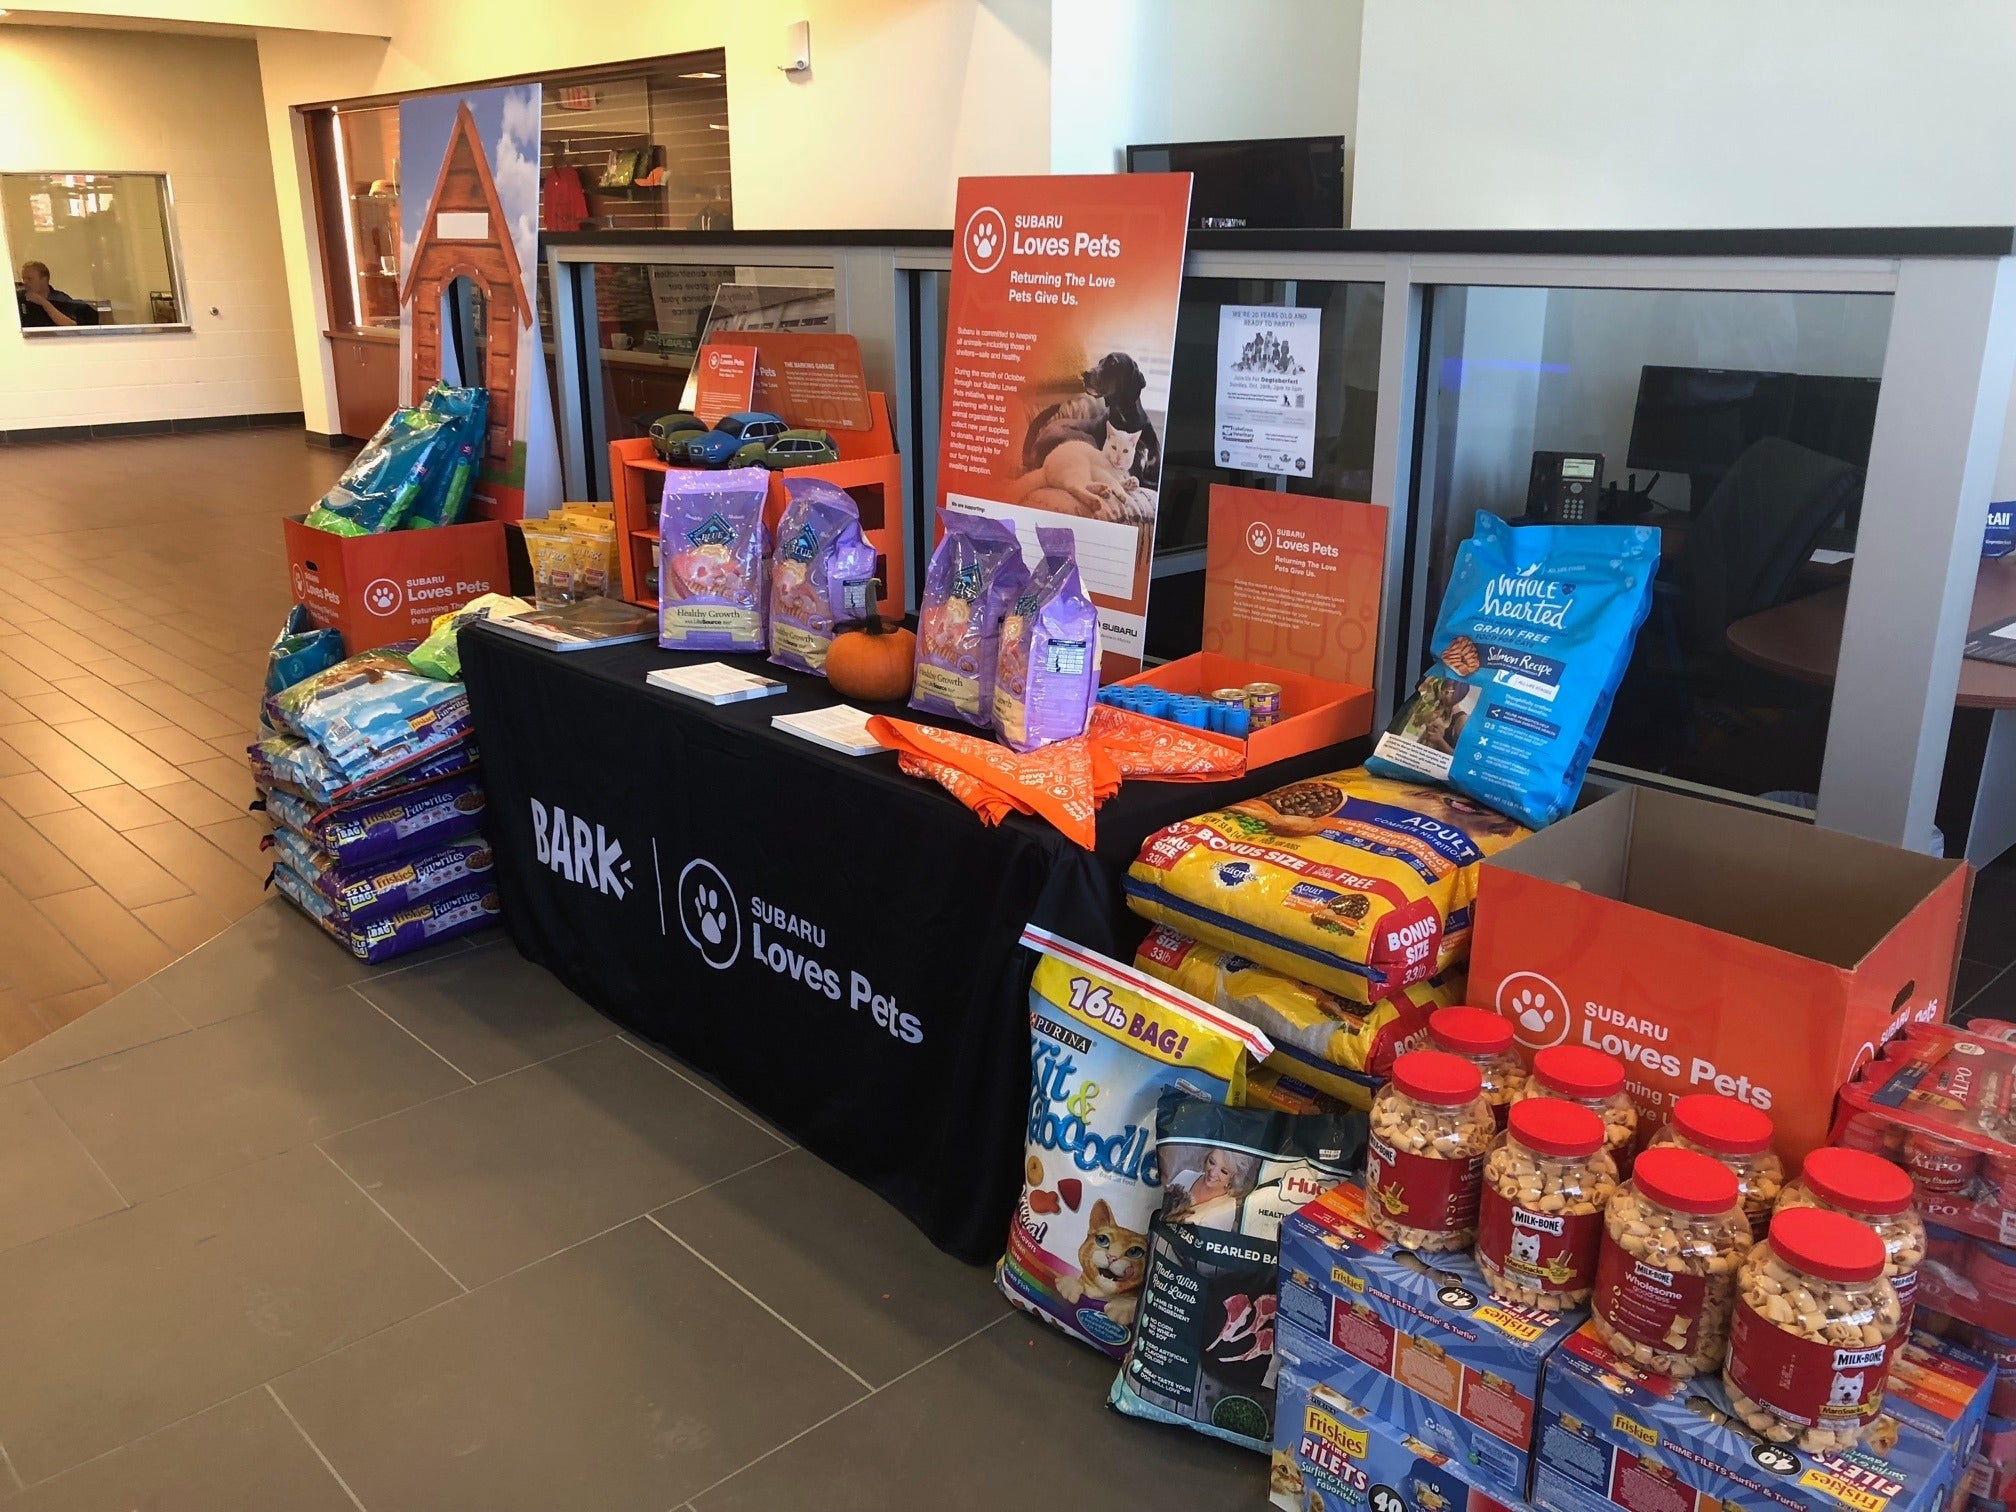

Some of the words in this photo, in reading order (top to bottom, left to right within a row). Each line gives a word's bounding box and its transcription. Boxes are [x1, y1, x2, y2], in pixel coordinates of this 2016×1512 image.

[1014, 215, 1063, 229] SUBARU
[1012, 231, 1070, 257] Loves
[1074, 232, 1121, 258] Pets
[1010, 270, 1062, 288] Returning
[1065, 273, 1085, 287] The
[1088, 275, 1116, 288] Love
[1008, 289, 1032, 303] Pets
[1034, 291, 1058, 304] Give
[1061, 293, 1078, 305] Us.
[760, 367, 776, 378] Pets
[794, 362, 815, 370] BARKING
[1260, 376, 1298, 384] Dogtoberfest
[1276, 528, 1305, 539] SUBARU
[1276, 536, 1310, 554] Loves
[1312, 542, 1339, 558] Pets
[1274, 564, 1289, 574] Pets
[1290, 566, 1304, 576] Give
[1275, 556, 1306, 568] Returning
[1307, 560, 1320, 569] The
[1321, 562, 1337, 572] Love
[406, 576, 444, 587] SUBARU
[408, 586, 452, 602] Loves
[456, 581, 490, 595] Pets
[1498, 574, 1560, 600] WHOLE
[306, 583, 323, 598] Loves
[324, 587, 340, 604] Pets
[410, 604, 449, 616] Returning
[677, 609, 706, 618] Healthy
[708, 610, 740, 618] Growth
[1479, 579, 1574, 630] hearted
[412, 617, 429, 625] Pets
[1102, 623, 1138, 637] SUBARU
[789, 631, 814, 642] Growth
[1474, 623, 1516, 636] GRAIN
[1518, 630, 1551, 644] FREE
[1488, 646, 1518, 664] Salmon
[1520, 654, 1552, 677] Recipe
[937, 674, 963, 686] Growth
[1338, 820, 1378, 835] ROASTED
[1380, 831, 1425, 850] CHICKEN,
[1427, 851, 1449, 870] RICE
[1374, 817, 1418, 834] COMPLETE
[1421, 831, 1464, 862] NUTRITION
[1402, 817, 1475, 858] ADULT
[530, 797, 625, 901] BARK
[1152, 841, 1179, 859] SIZE
[1196, 828, 1263, 858] BONUS
[1264, 851, 1308, 870] SIZE
[1355, 828, 1406, 848] VEGETABLE
[1406, 842, 1444, 874] FLAVOR
[375, 869, 414, 888] Friskies
[1211, 862, 1256, 881] Pedigree
[1336, 872, 1376, 890] FREE
[360, 884, 371, 892] LB
[1297, 884, 1322, 895] ADULT
[751, 896, 827, 949] SUBARU
[1156, 934, 1181, 952] SIZE
[1387, 916, 1437, 952] BONUS
[1150, 946, 1171, 963] 33lb
[1406, 939, 1430, 965] SIZE
[752, 922, 842, 1001] Loves
[850, 970, 924, 1044] Pets
[1069, 976, 1127, 1028] 16lb
[1128, 1013, 1189, 1060] BAG!
[1584, 1001, 1669, 1042] SUBARU
[1881, 1007, 1911, 1042] SUBARU
[1036, 1016, 1089, 1052] PURINA
[1582, 1019, 1681, 1077] Loves
[1690, 1057, 1772, 1110] Pets
[1948, 1066, 1973, 1101] ALPO
[1066, 1080, 1100, 1125] &
[1911, 1156, 1962, 1171] ALPO
[1515, 1210, 1560, 1232] MILK-BONE
[1177, 1228, 1194, 1244] PEAS
[1206, 1242, 1261, 1262] PEARLED
[1156, 1261, 1175, 1281] Made
[1176, 1274, 1199, 1292] With
[1506, 1257, 1543, 1275] MaroSnacks
[1637, 1265, 1670, 1283] MILK-BONE
[1152, 1274, 1167, 1292] Real
[1168, 1285, 1196, 1304] Lamb
[1333, 1270, 1363, 1291] Friskies
[1625, 1272, 1682, 1300] Wholesome
[1441, 1292, 1472, 1307] 40
[1633, 1285, 1670, 1303] goodness
[1153, 1296, 1167, 1307] LAMB
[1173, 1306, 1184, 1315] THE
[1158, 1304, 1190, 1323] INGREDIENT
[1368, 1286, 1391, 1303] PRIME
[1392, 1296, 1417, 1315] FILETS
[1418, 1310, 1442, 1326] Surfin'
[1443, 1320, 1450, 1330] &
[1451, 1325, 1478, 1342] Turfin'
[1157, 1321, 1174, 1332] CORN
[1482, 1306, 1536, 1336] Friskies
[1156, 1325, 1177, 1339] WHEAT
[1145, 1346, 1167, 1362] FLAVORS
[1159, 1348, 1189, 1364] ARTIFICIAL
[1837, 1351, 1883, 1365] MILK-BONE
[1151, 1379, 1165, 1389] WILL
[1166, 1385, 1181, 1395] LOVE
[1158, 1376, 1174, 1387] TASTE
[1175, 1383, 1191, 1393] YOUR
[1823, 1407, 1864, 1415] MaroSnacks
[1309, 1412, 1363, 1453] Friskies
[1616, 1418, 1655, 1444] Friskies
[1321, 1437, 1347, 1459] Prime
[1769, 1446, 1794, 1461] CANS
[1300, 1438, 1368, 1492] FILETS
[1758, 1454, 1794, 1471] 40
[1301, 1461, 1328, 1481] Surfin'
[1336, 1478, 1363, 1502] Turfin'
[1663, 1440, 1692, 1460] PRIME
[1694, 1454, 1727, 1476] FILETS
[1729, 1472, 1761, 1490] Surfin'
[1763, 1488, 1772, 1496] &
[1774, 1492, 1807, 1512] Turfin'
[1811, 1453, 1903, 1497] FILETS
[1316, 1478, 1356, 1506] Favorites
[1374, 1491, 1402, 1512] 40
[1811, 1472, 1879, 1510] Friskies
